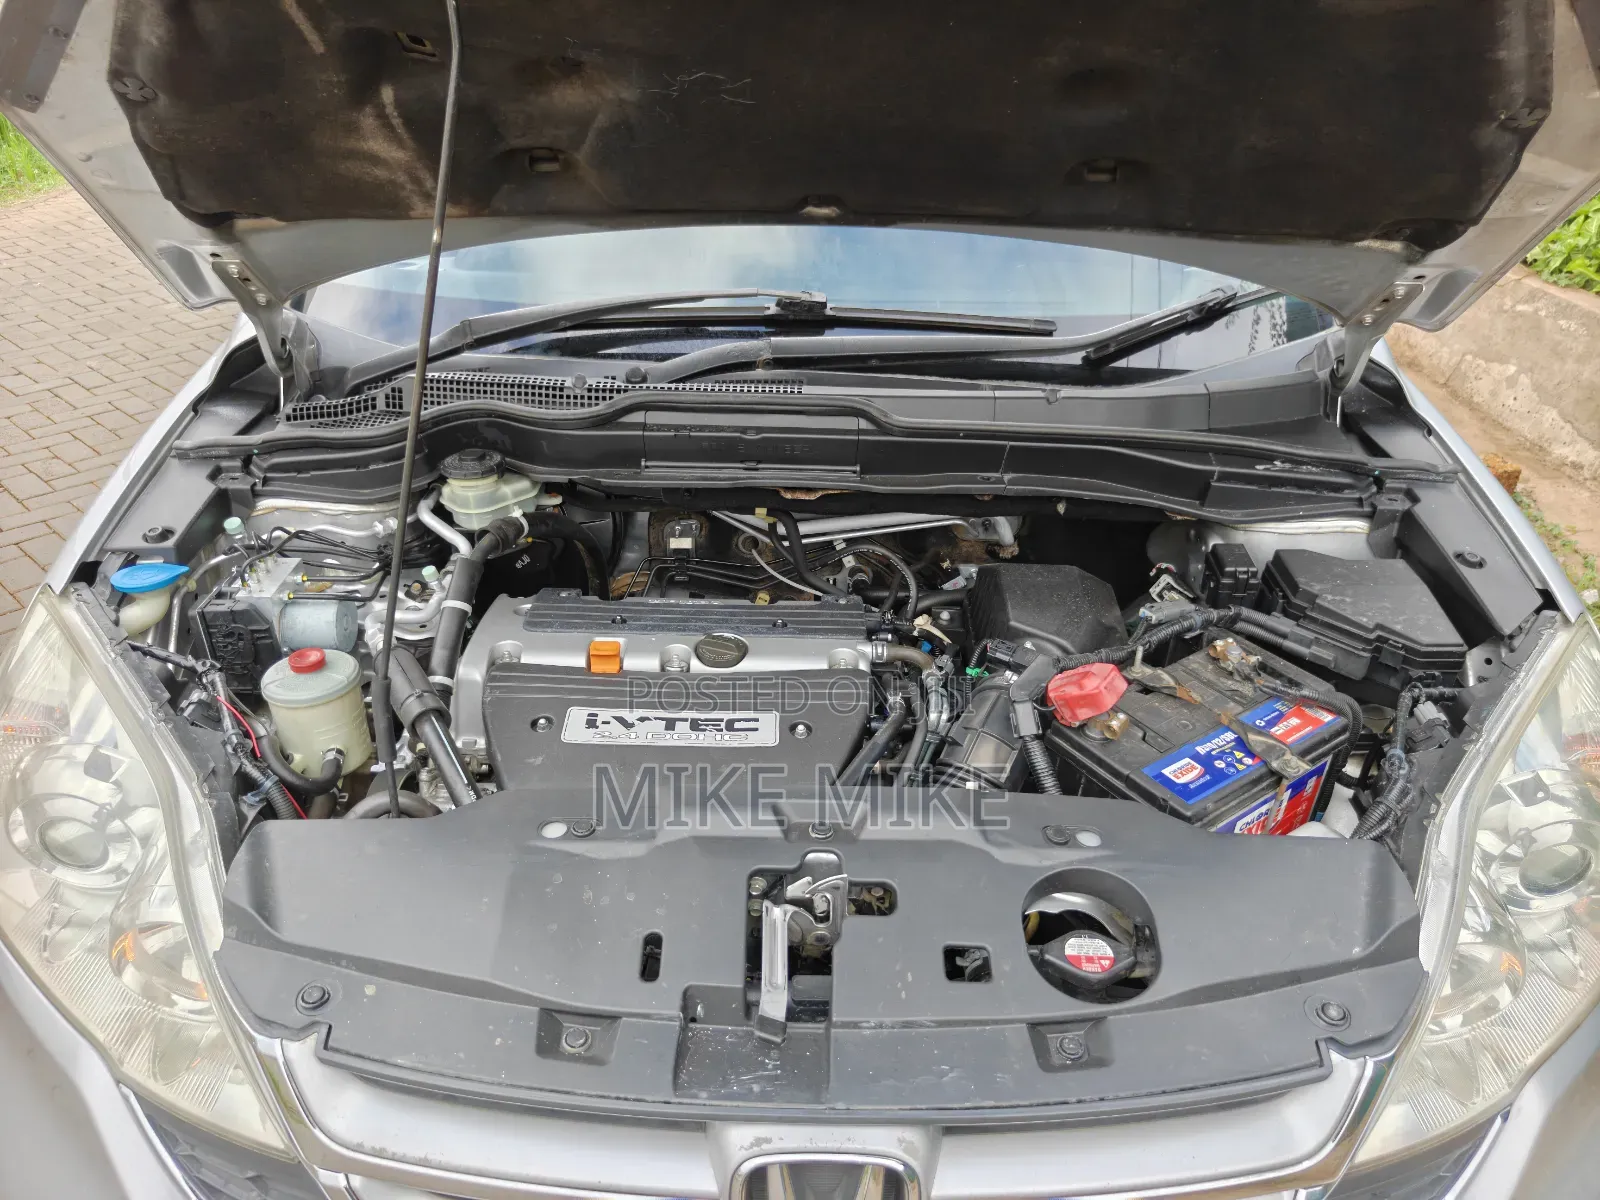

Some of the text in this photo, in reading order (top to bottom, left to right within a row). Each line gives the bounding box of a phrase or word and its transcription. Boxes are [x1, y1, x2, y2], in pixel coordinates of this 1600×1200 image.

[592, 731, 749, 741] 2.4 DOHC
[1172, 764, 1199, 780] EXIDE
